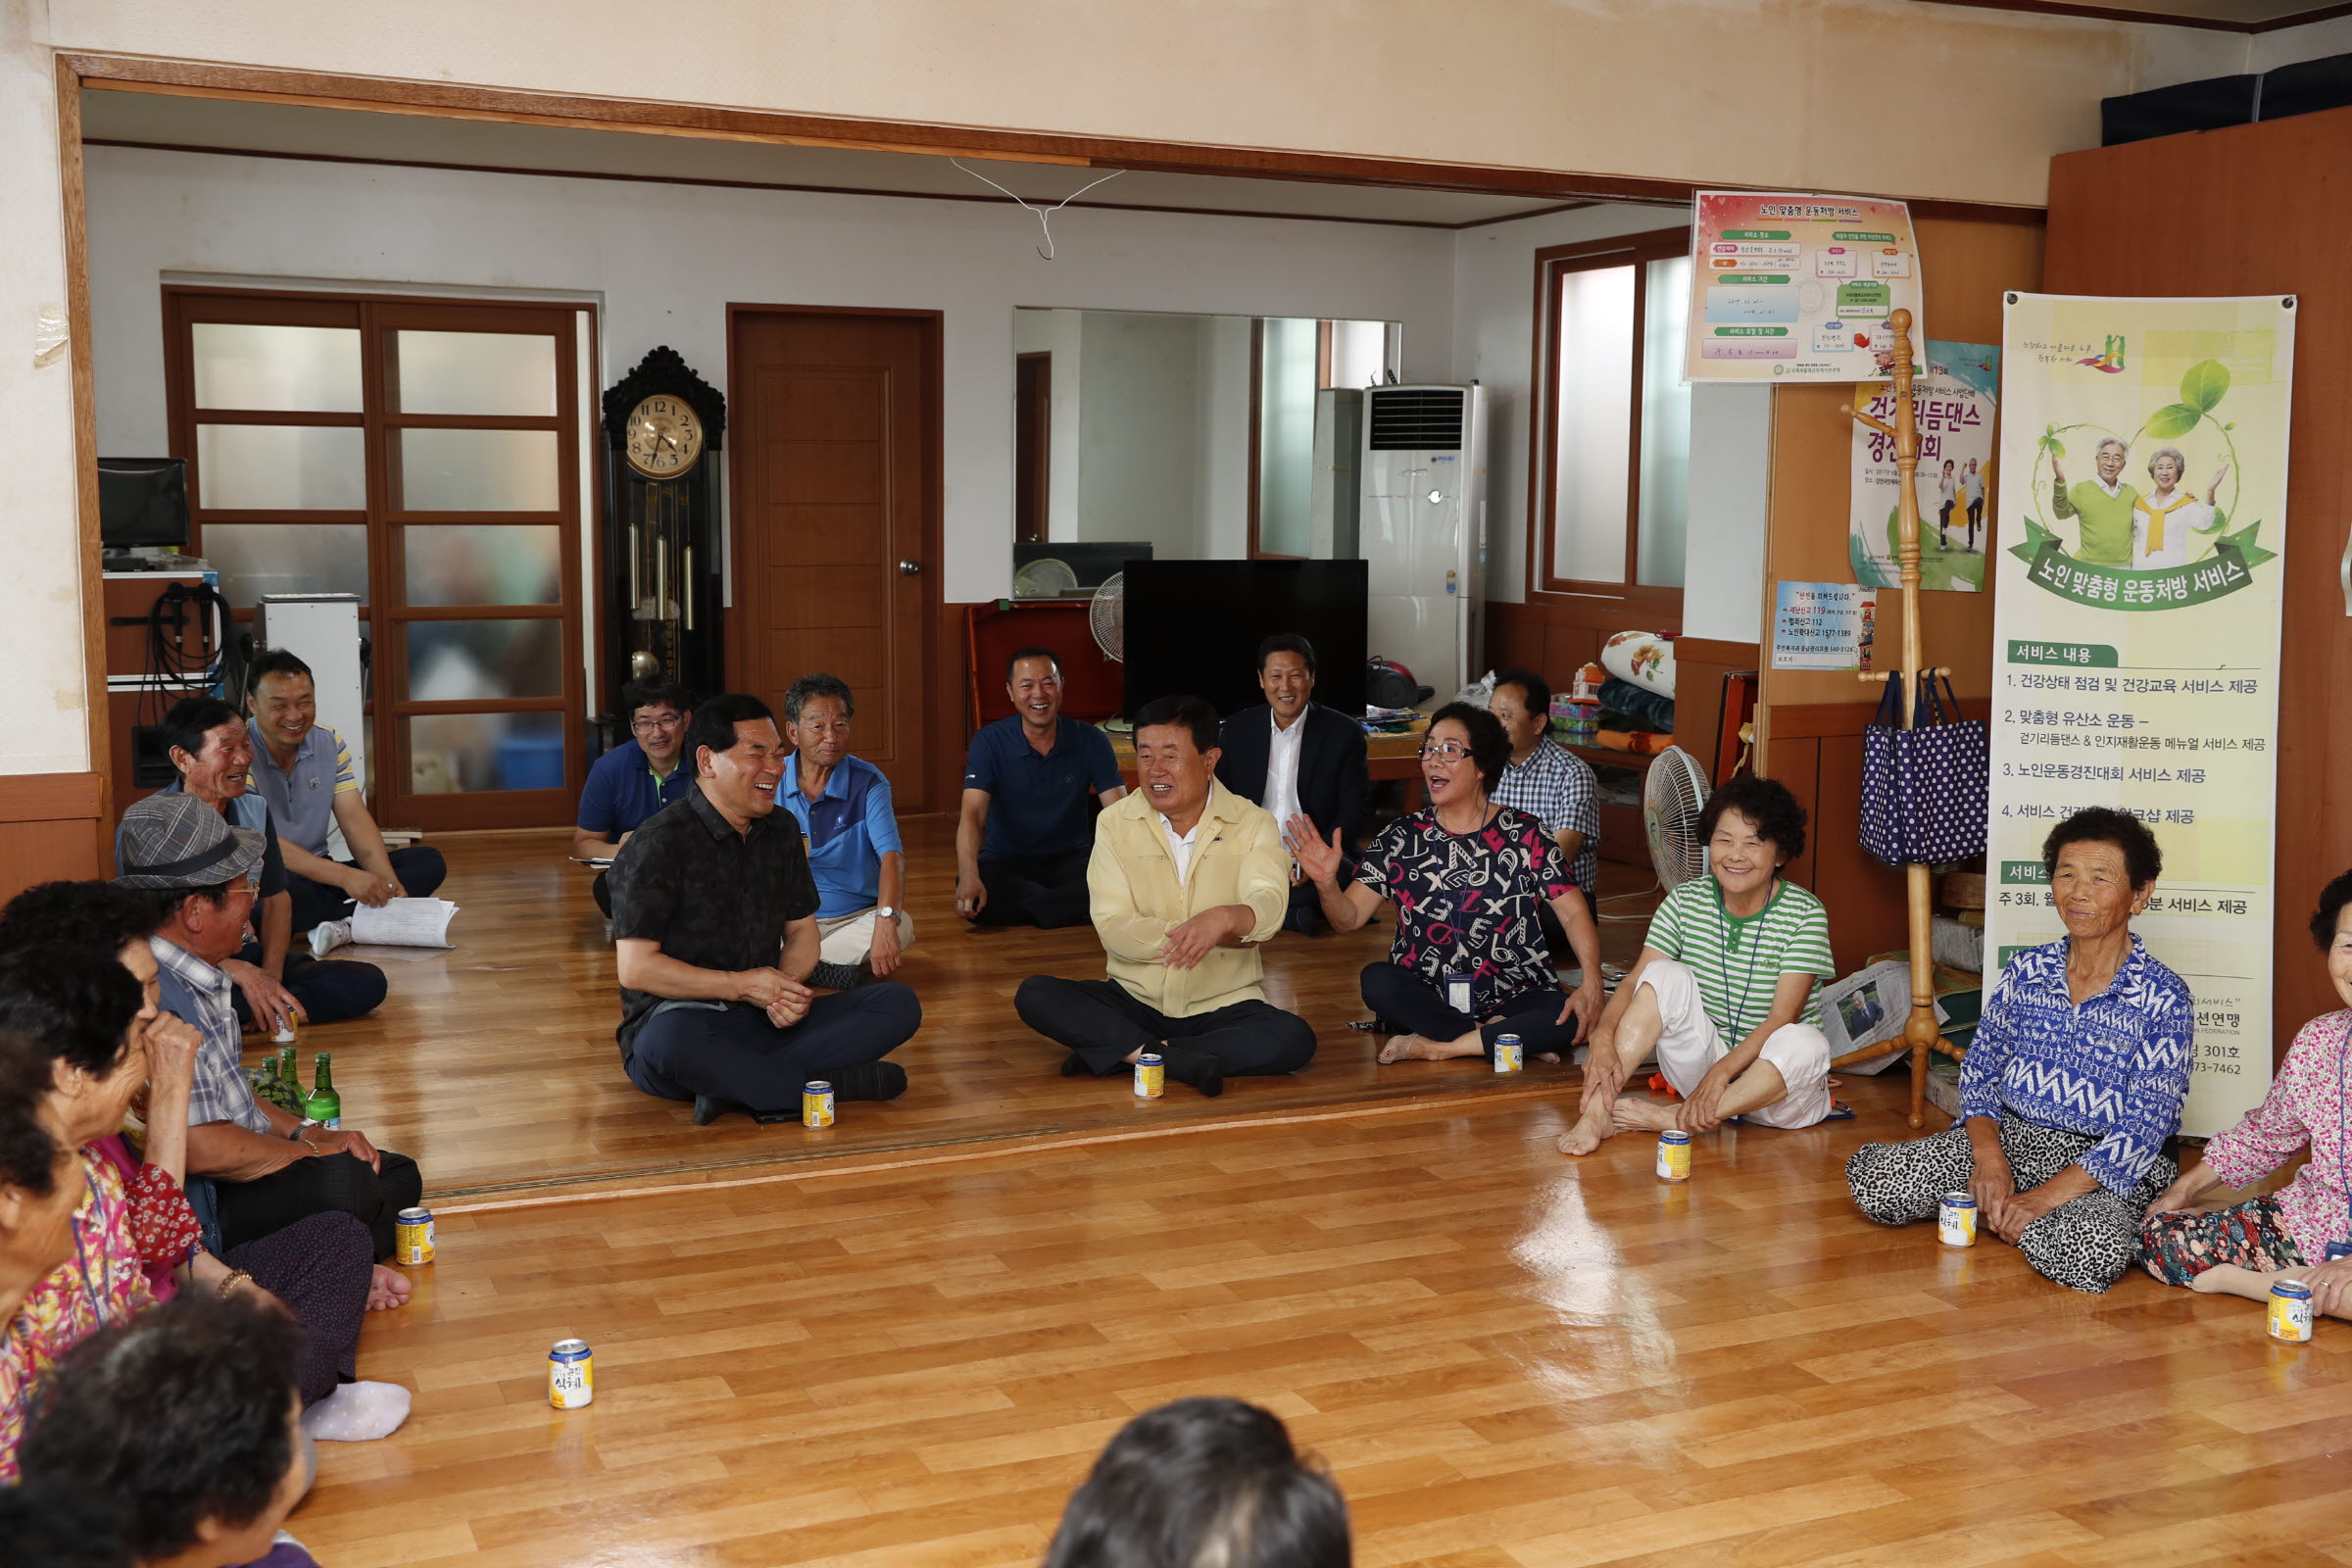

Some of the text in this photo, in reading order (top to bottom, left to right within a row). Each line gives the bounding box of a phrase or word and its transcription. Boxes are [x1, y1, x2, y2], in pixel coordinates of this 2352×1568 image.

[1760, 205, 1859, 217] 노인 맞춤형 운동처방 서비스
[1935, 387, 1952, 396] 서비스
[641, 405, 649, 416] 11
[655, 401, 666, 413] 12
[629, 416, 641, 426] 10
[680, 416, 689, 426] 2
[628, 429, 636, 440] 9
[685, 429, 693, 441] 3
[632, 442, 641, 454] 8
[1867, 432, 1941, 464] 경회
[656, 457, 665, 468] 6
[669, 454, 679, 466] 5
[2037, 557, 2245, 604] 노인 맞춤형 운동처방 서비스
[1788, 629, 1851, 637] 노인학대신고 1577-1389
[2016, 644, 2092, 663] 서비스 내용
[2006, 674, 2258, 695] 1. 건강상태 점검 및 건강교육 서비스 제공
[2005, 710, 2016, 724] 2.
[2019, 710, 2058, 726] 맞춤형
[2062, 712, 2103, 728] 유산소
[2107, 713, 2135, 729] 운동
[2019, 732, 2266, 752] 걷기리듬댄스 & 인지재활운동 메뉴얼 서비스 제공
[2003, 763, 2206, 784] 3. 노인운동경진대회 서비스 제공
[2002, 805, 2013, 818] 4.
[2017, 804, 2056, 819] 서비스
[2165, 809, 2195, 824] 제공
[2009, 864, 2049, 881] 서비스
[1999, 893, 2011, 906] 주
[2015, 892, 2039, 907] 3회,
[2168, 899, 2212, 912] 서비스
[2217, 899, 2248, 915] 제공
[2204, 1045, 2240, 1058] 301호
